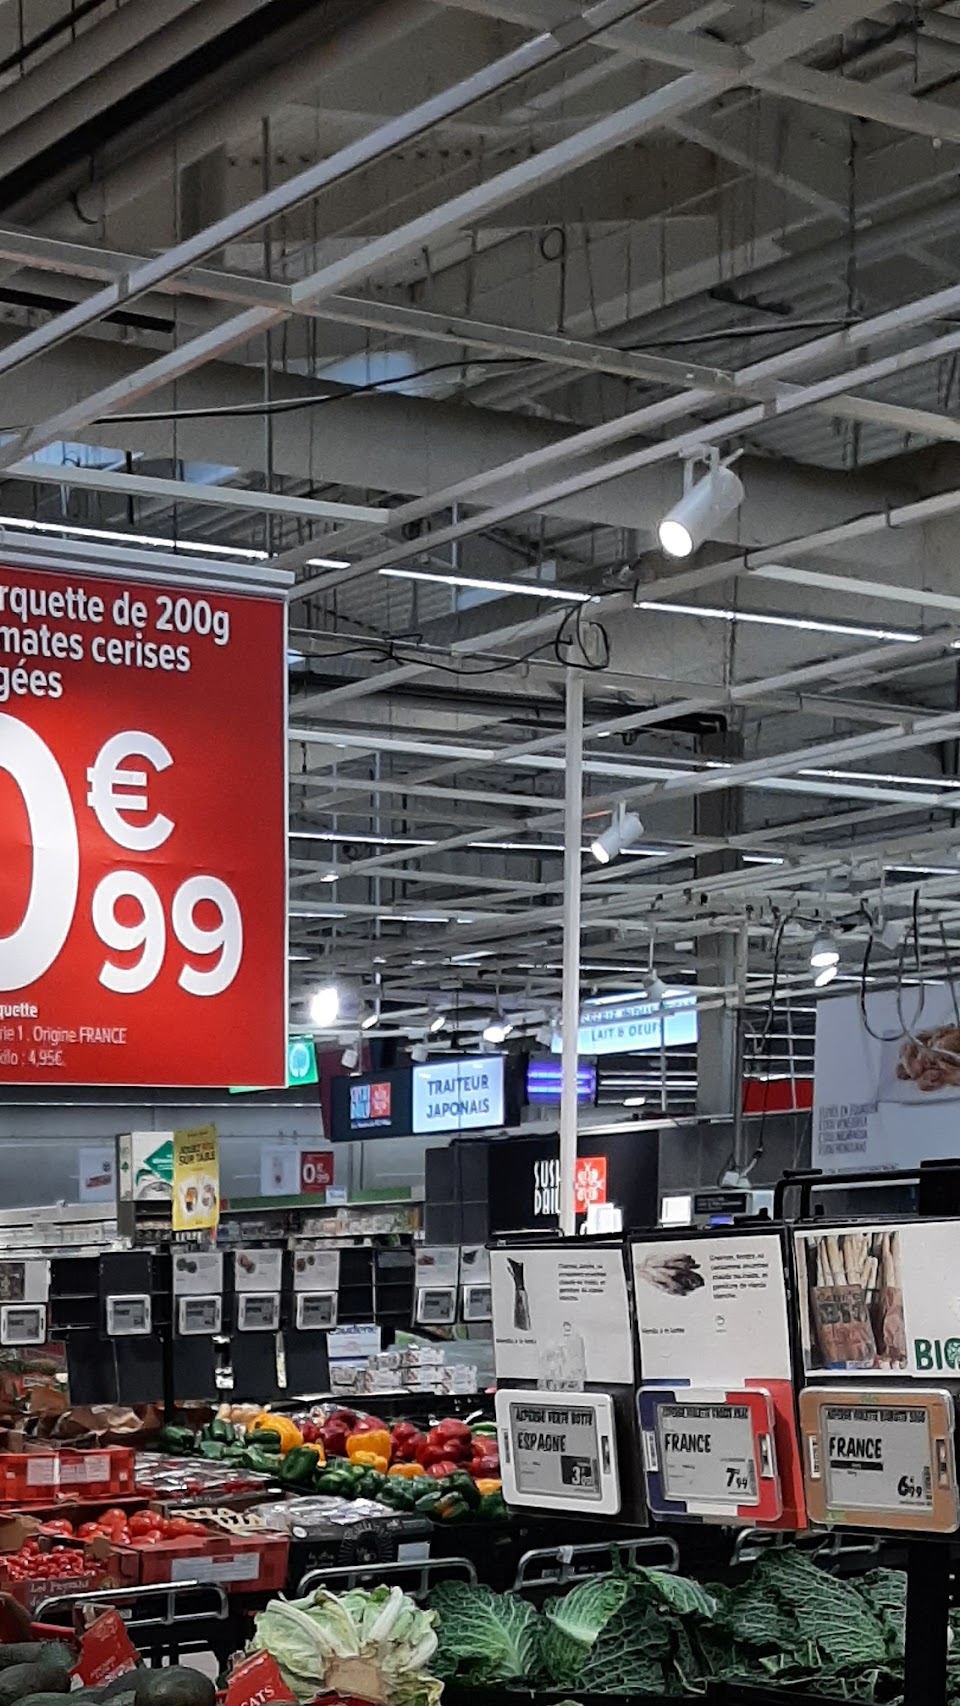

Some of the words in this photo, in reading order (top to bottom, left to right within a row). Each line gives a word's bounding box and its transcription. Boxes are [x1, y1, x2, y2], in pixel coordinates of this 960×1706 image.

[112, 591, 148, 628] de
[156, 595, 230, 646] 200g
[92, 632, 191, 672] cerises
[87, 731, 174, 851] €
[92, 870, 243, 996] 99
[629, 1022, 662, 1037] OEUF
[427, 1074, 489, 1096] TRAITEUR
[426, 1098, 490, 1119] JAPONAIS
[518, 1432, 566, 1452] ESPAGNE
[664, 1433, 711, 1453] FRANCE
[829, 1436, 882, 1459] FRANCE
